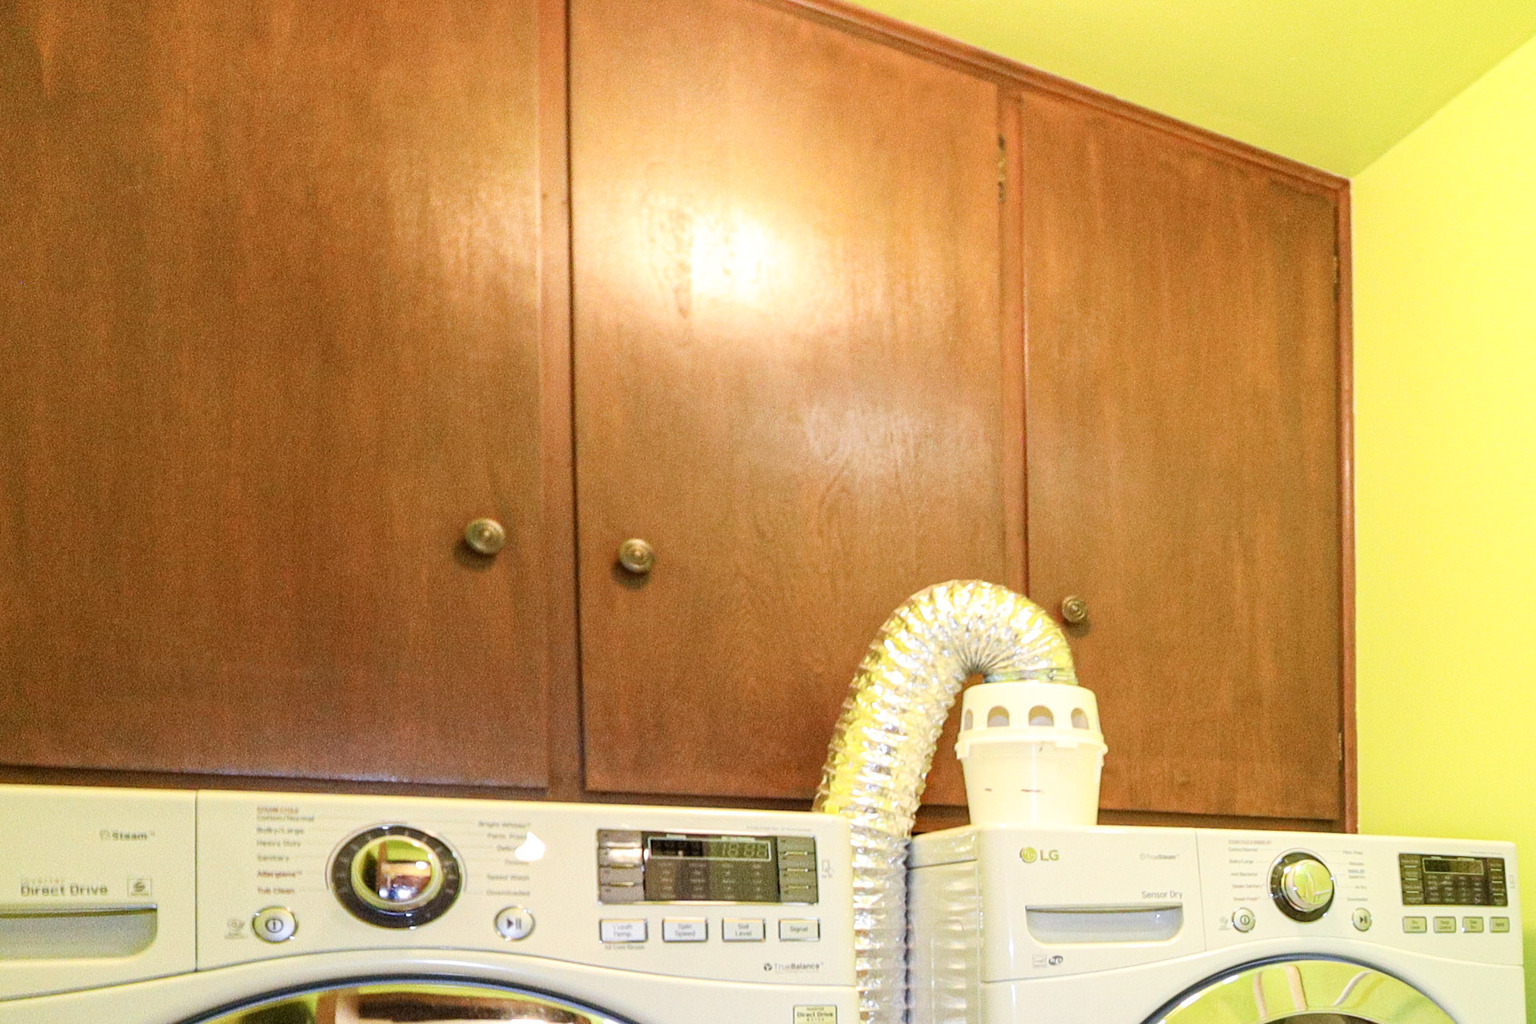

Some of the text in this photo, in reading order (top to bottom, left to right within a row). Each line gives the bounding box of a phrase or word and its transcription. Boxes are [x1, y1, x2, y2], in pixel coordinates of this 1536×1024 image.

[112, 829, 148, 841] Steam
[1040, 849, 1060, 862] LG
[20, 884, 109, 897] Direct Drive
[1141, 890, 1183, 900] Sensor Dry
